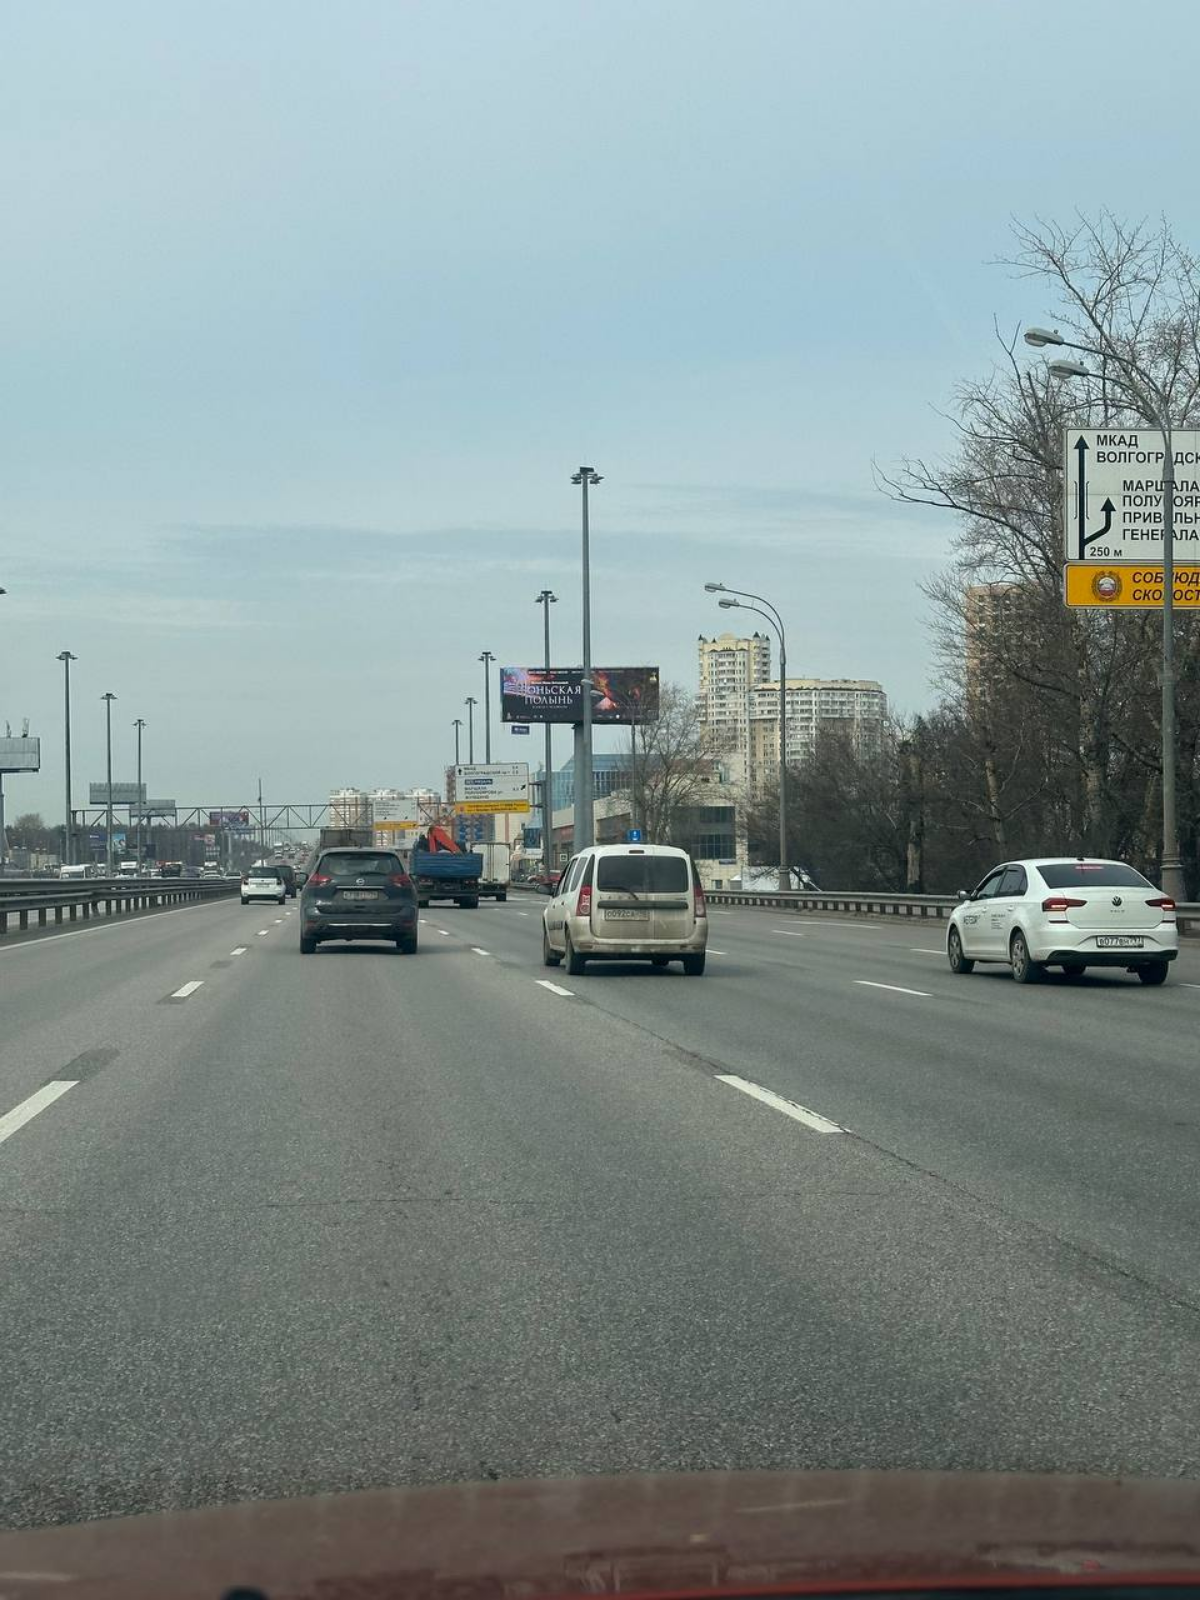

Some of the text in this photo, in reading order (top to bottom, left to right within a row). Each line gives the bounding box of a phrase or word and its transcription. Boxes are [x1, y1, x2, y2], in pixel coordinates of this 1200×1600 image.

[1096, 434, 1139, 448] МКАД
[1096, 451, 1200, 465] ВОЛГОГРДС
[1122, 495, 1200, 507] ПОЛУОЯР
[1122, 512, 1200, 524] ПРИВЛЬН
[1090, 546, 1110, 557] 250
[1132, 571, 1200, 587] СОБЮД
[1132, 589, 1200, 601] СКООСТ
[525, 695, 573, 705] ПОЛЫНЬ
